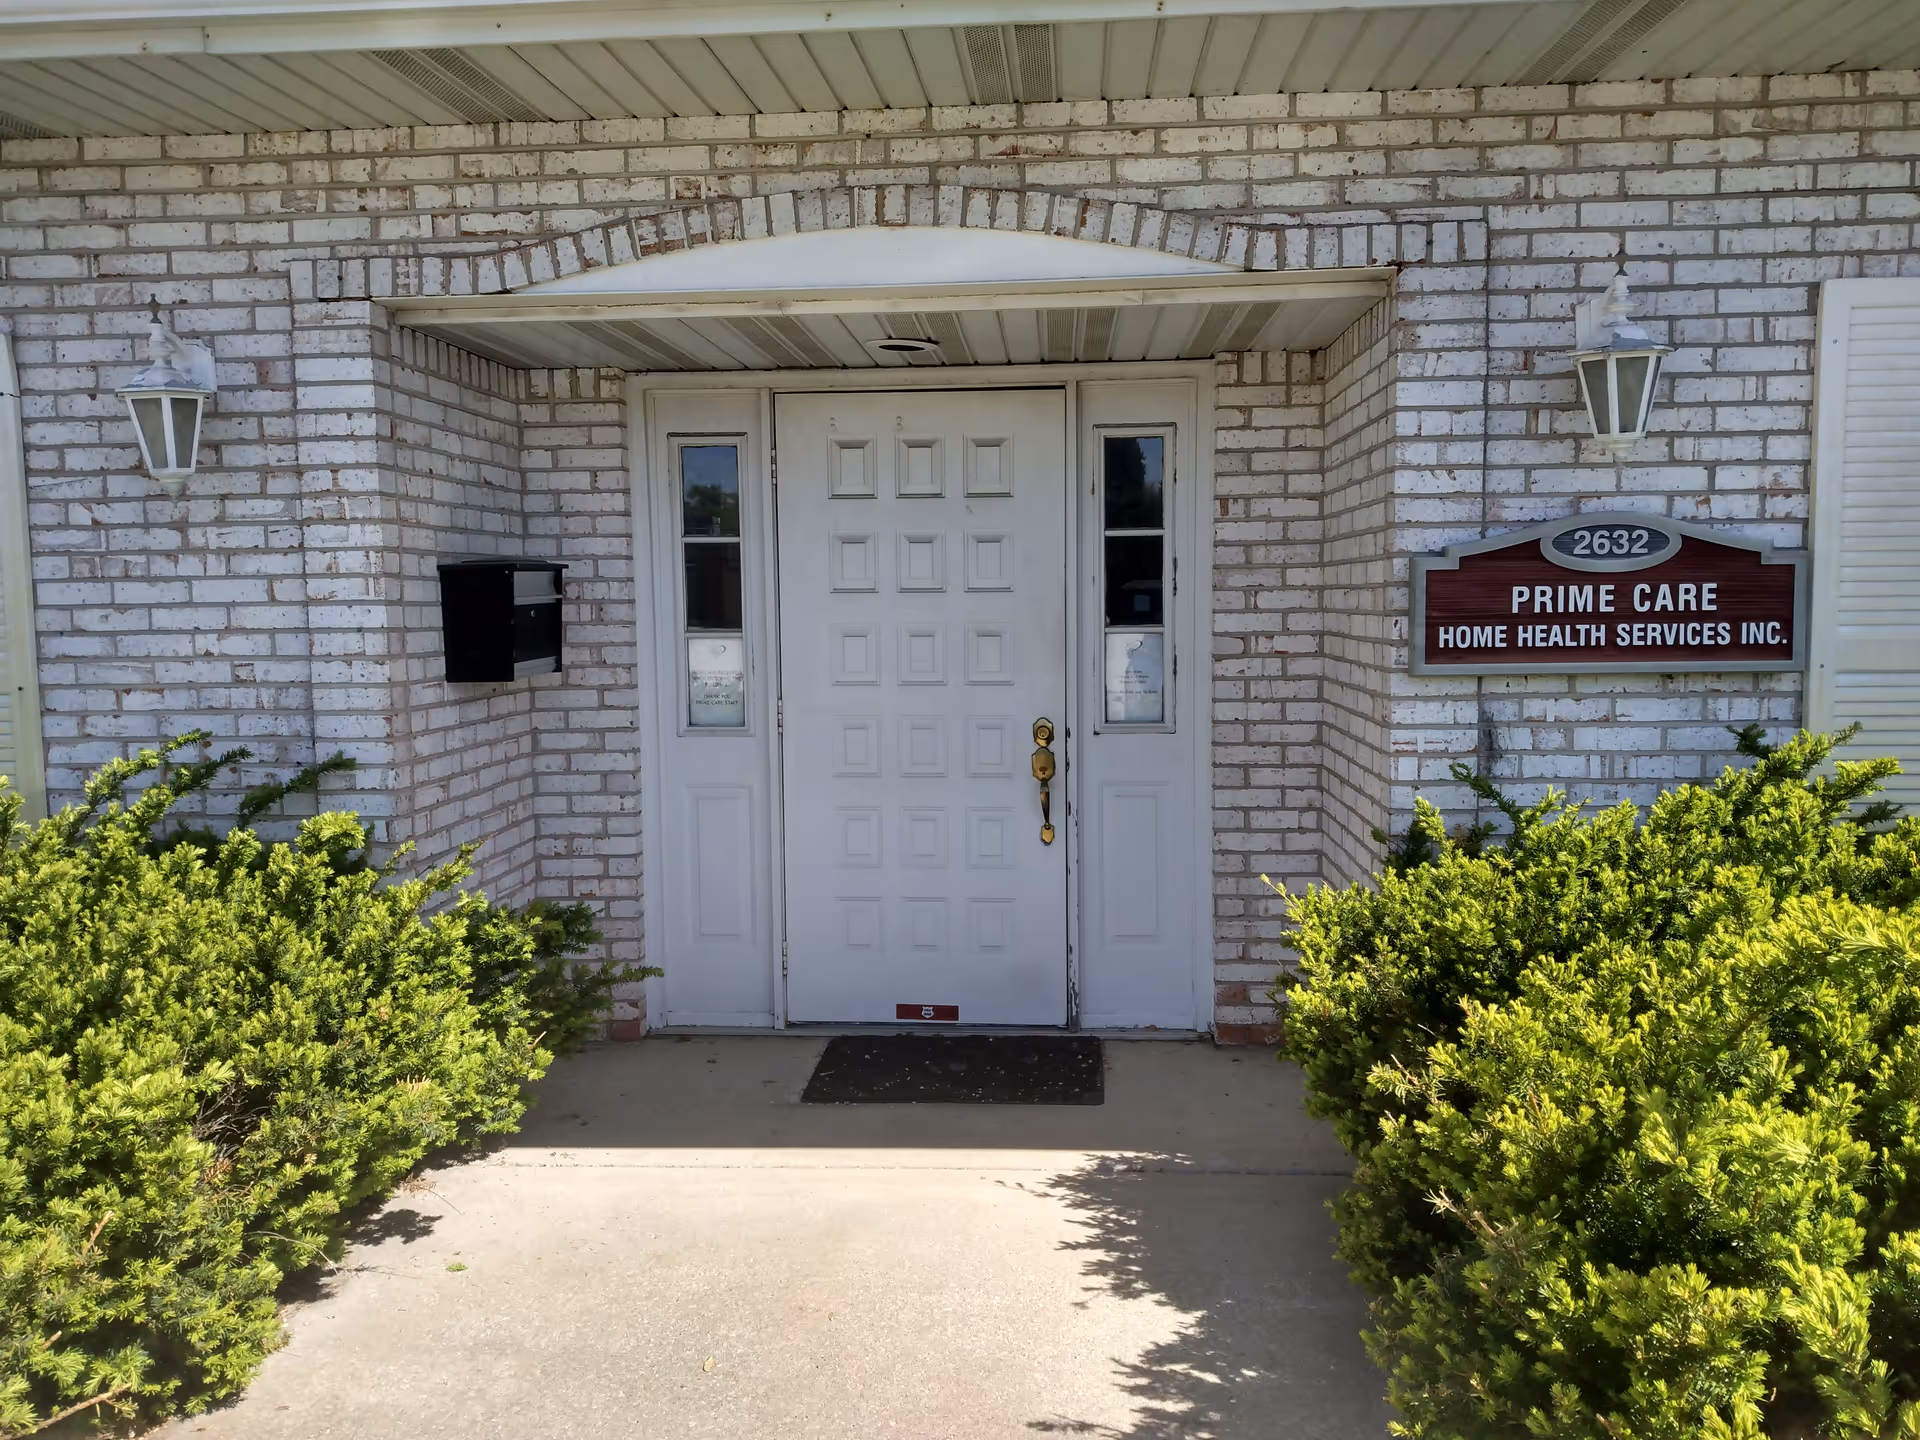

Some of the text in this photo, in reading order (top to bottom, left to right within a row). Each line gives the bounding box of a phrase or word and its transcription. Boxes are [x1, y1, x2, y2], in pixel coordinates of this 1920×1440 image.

[1573, 529, 1649, 555] 2632
[1511, 582, 1718, 614] PRIME CARE
[1438, 621, 1788, 649] HOME HEALTH SERVICES INC.
